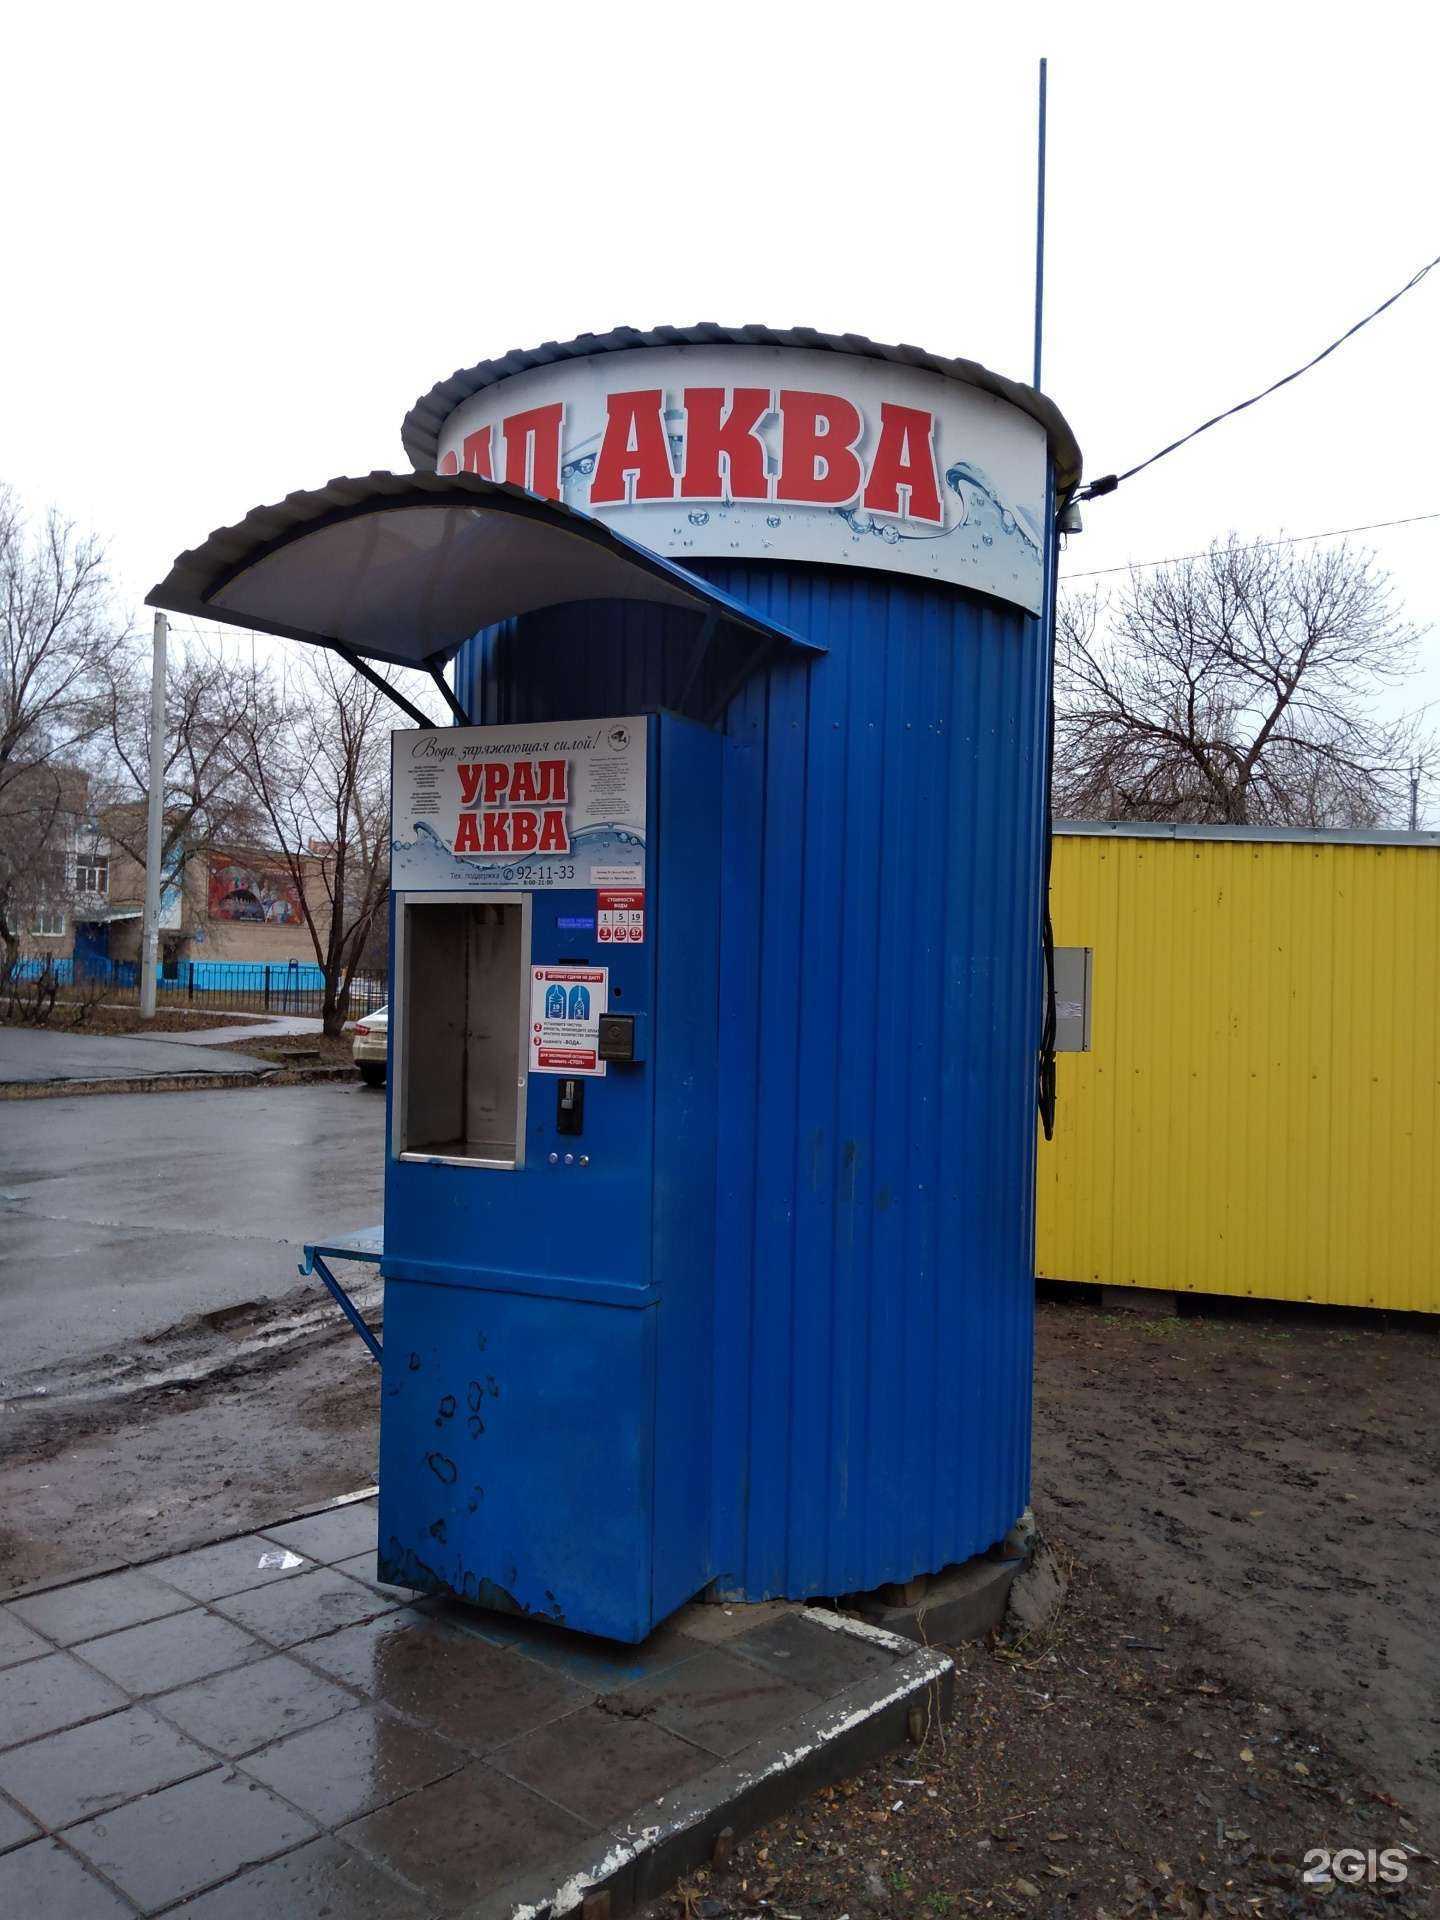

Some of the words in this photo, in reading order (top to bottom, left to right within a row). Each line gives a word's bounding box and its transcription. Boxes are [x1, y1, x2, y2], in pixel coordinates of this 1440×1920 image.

[590, 387, 943, 524] АКВА
[458, 741, 549, 761] заряжающая
[553, 730, 602, 752] силой!
[456, 760, 567, 804] УРАЛ
[454, 811, 569, 852] АКВА
[517, 866, 575, 880] 92-11-33
[618, 913, 624, 921] 5
[631, 913, 641, 921] 19
